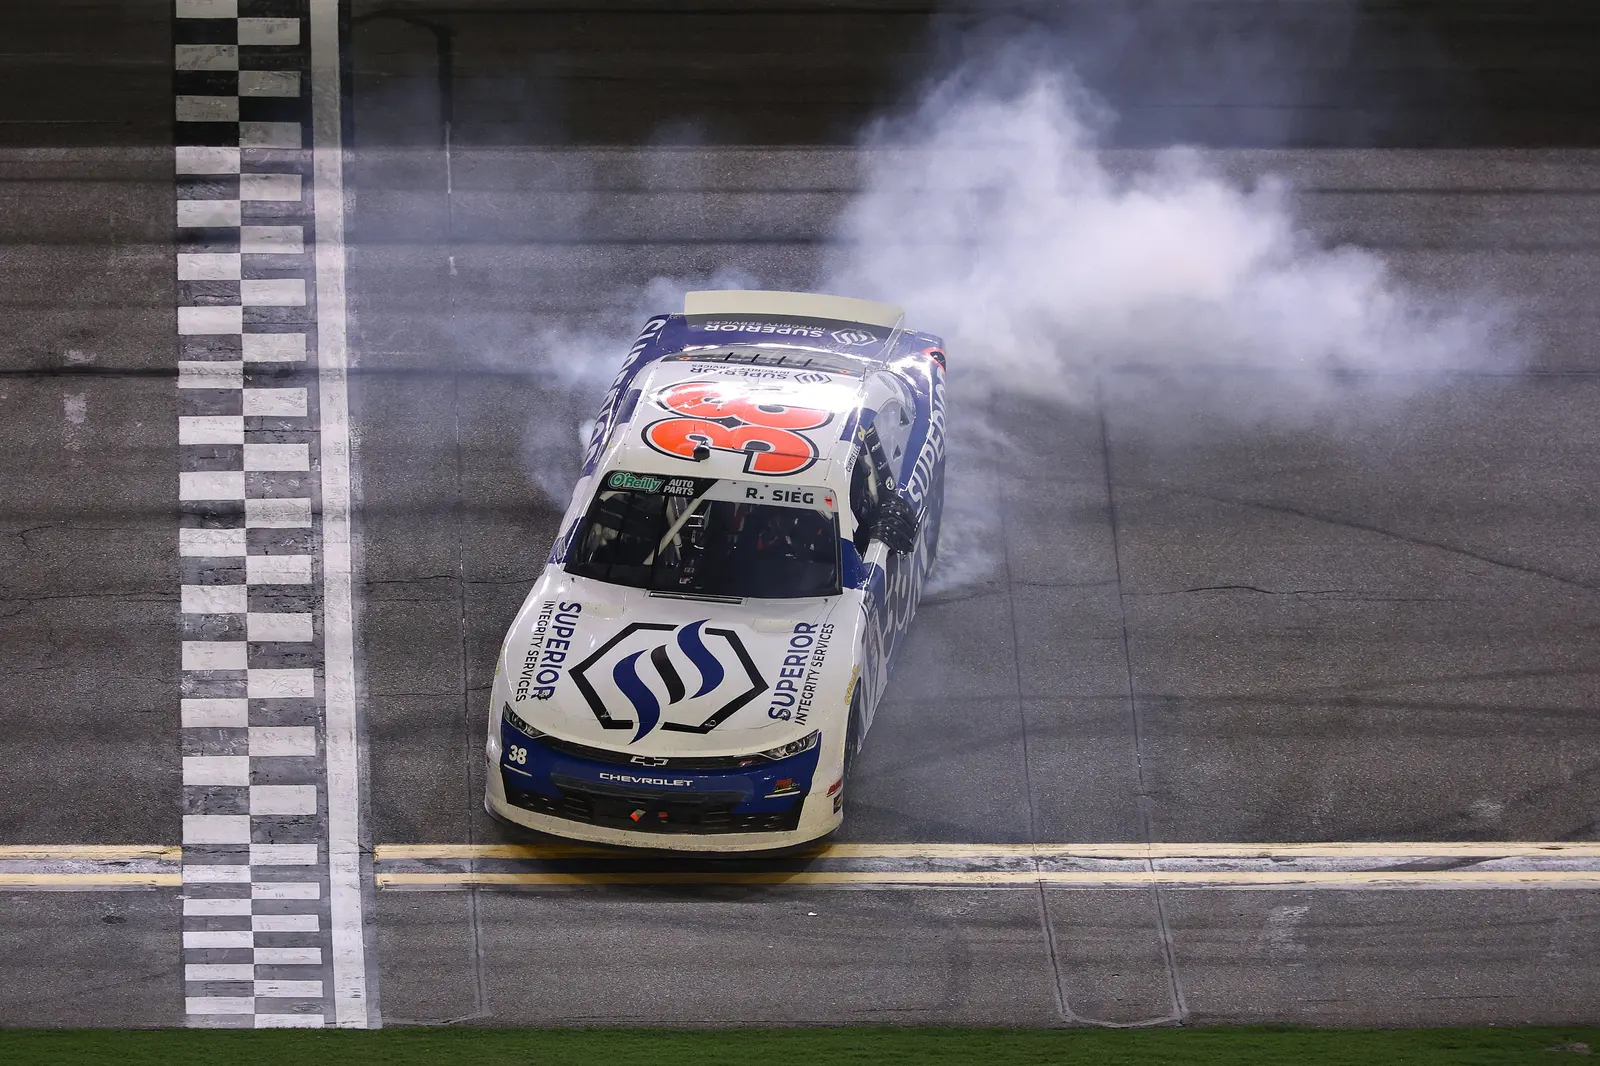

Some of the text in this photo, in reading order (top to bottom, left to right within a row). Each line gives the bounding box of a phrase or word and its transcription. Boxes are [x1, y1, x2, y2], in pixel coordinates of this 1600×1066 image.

[704, 324, 824, 338] SUPERIOR
[766, 322, 826, 332] INTEGRITY
[609, 472, 665, 493] O'Reilly
[663, 485, 694, 496] PARTS
[669, 479, 694, 488] AUTO
[745, 487, 814, 504] R. SIEG
[515, 600, 555, 702] INTEGRITY SERVICES
[530, 601, 582, 701] SUPERIOR
[768, 622, 818, 721] SUPERIOR
[794, 623, 835, 726] INTEGRITY SERVICES
[508, 745, 528, 765] 38
[599, 772, 694, 787] CHEVROLET
